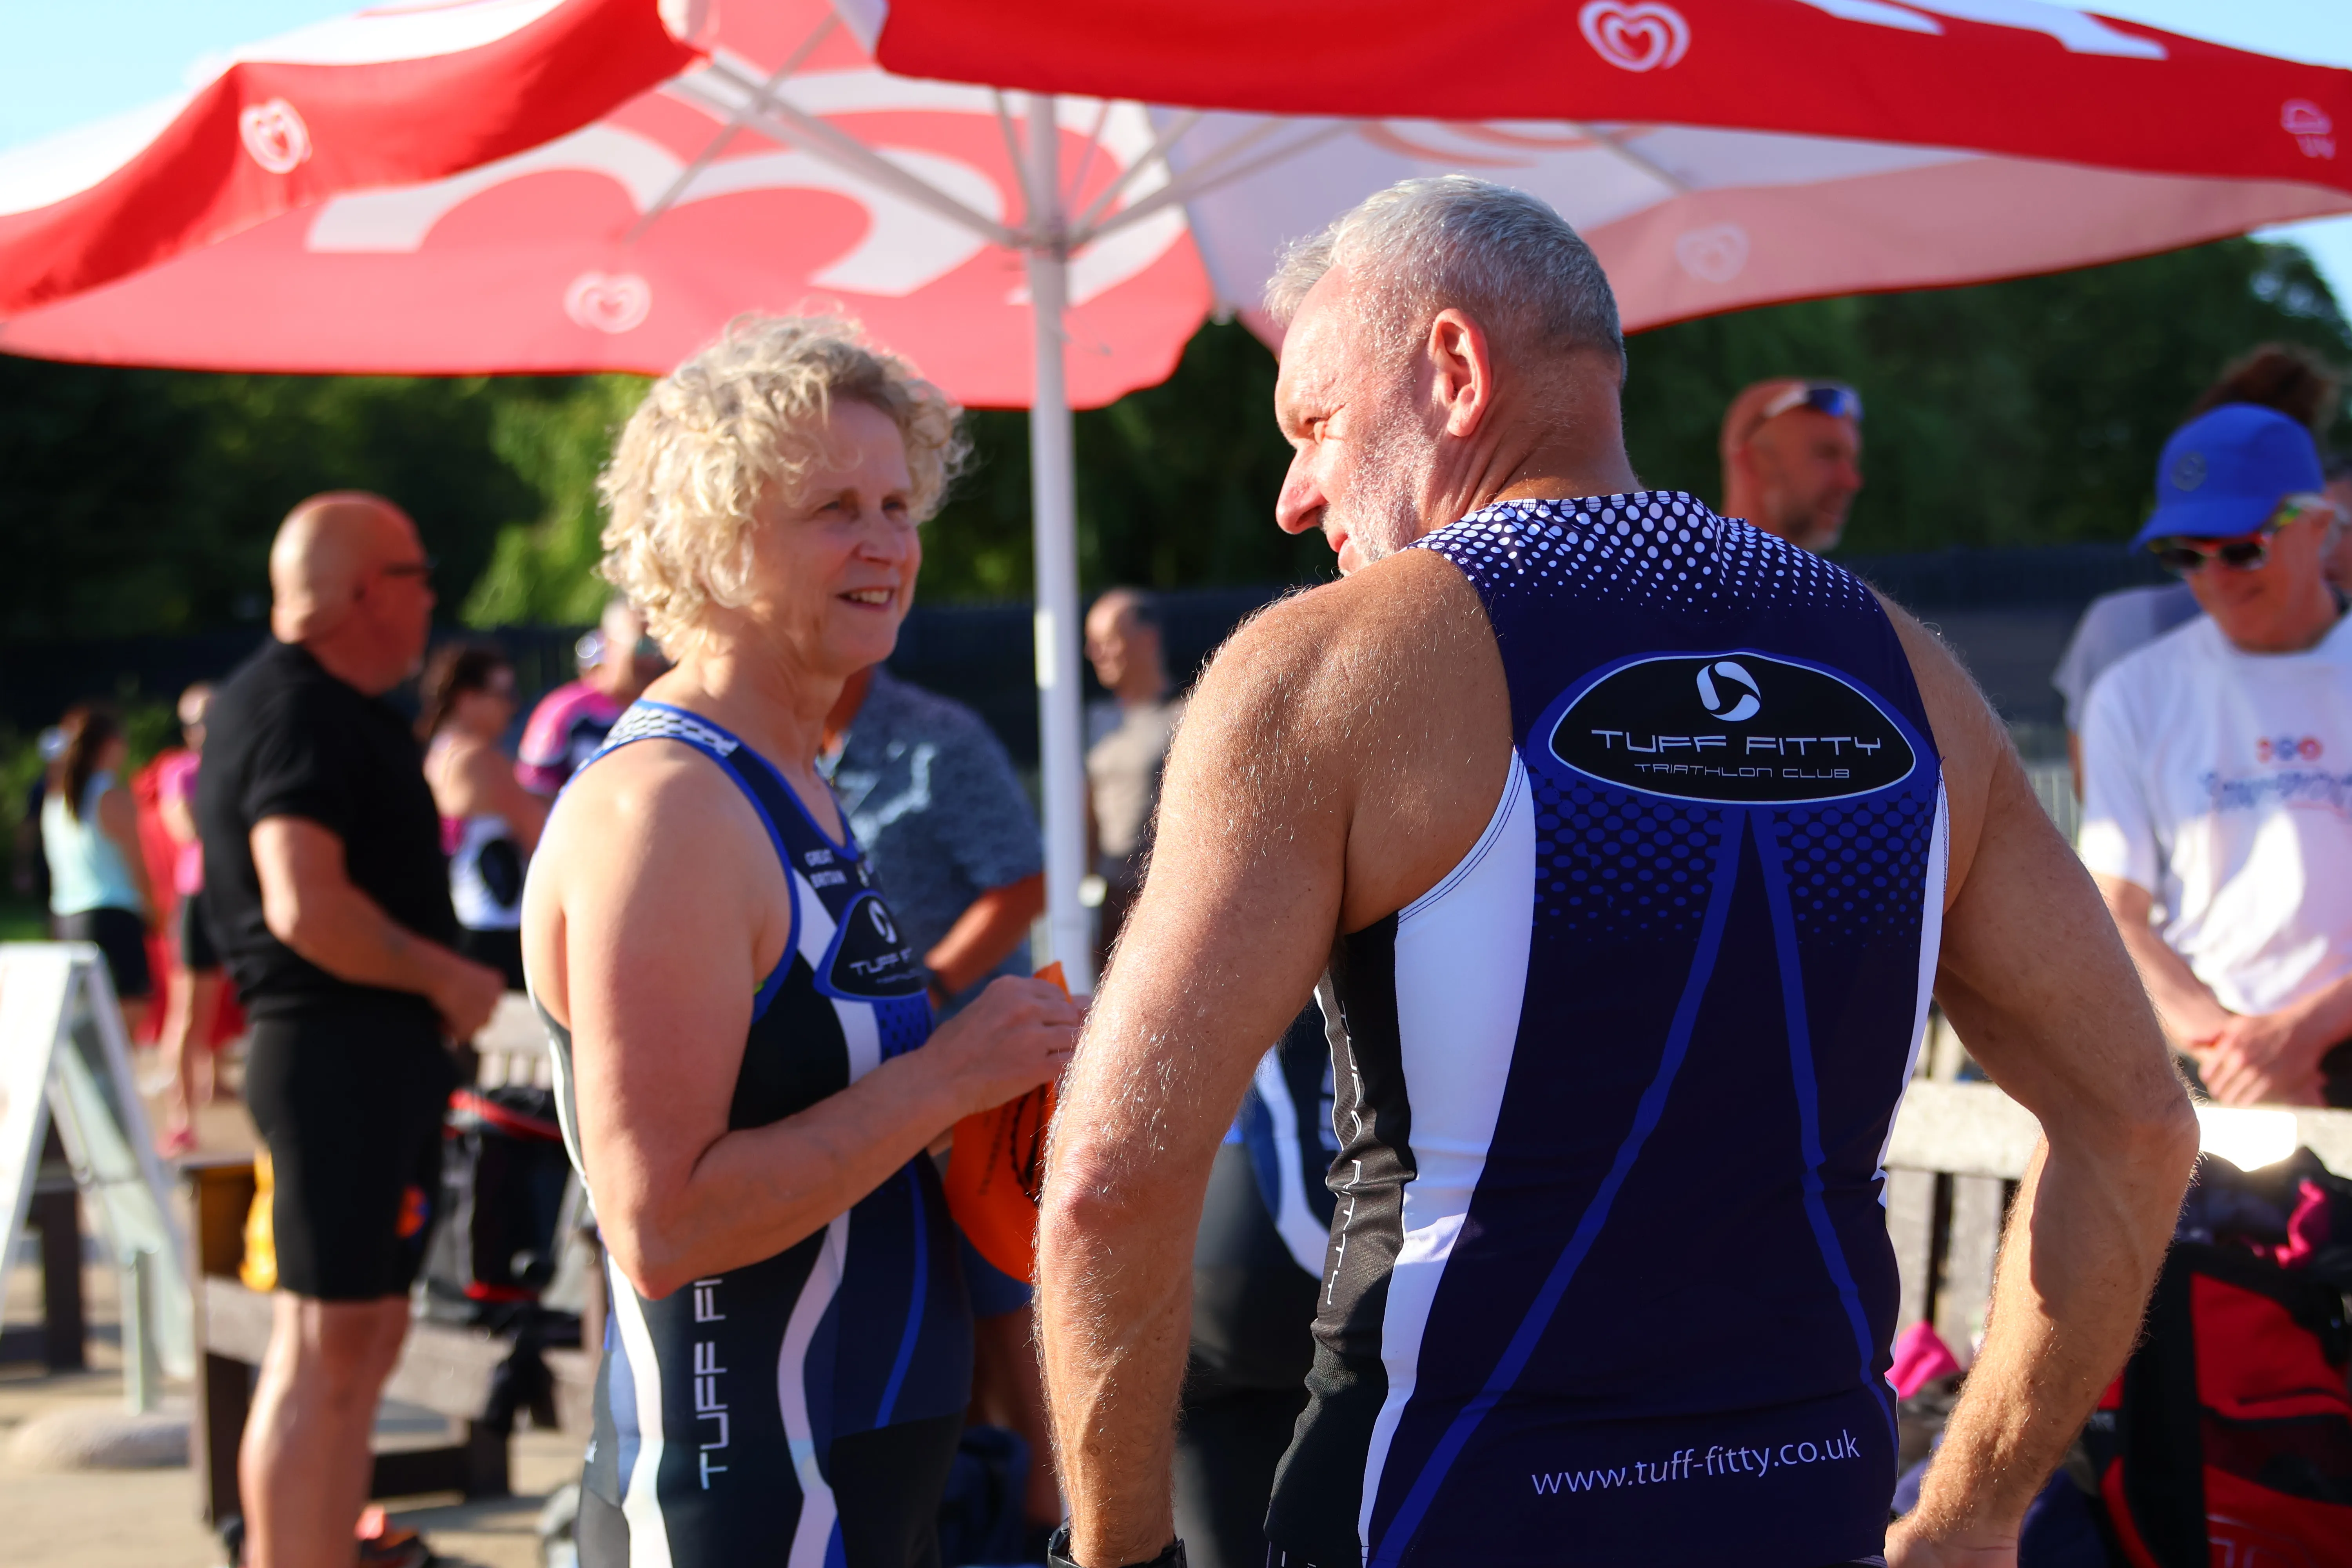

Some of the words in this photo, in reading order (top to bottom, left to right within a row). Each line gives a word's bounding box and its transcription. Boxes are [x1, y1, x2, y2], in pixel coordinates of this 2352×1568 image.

[1592, 730, 1727, 753] TUFF
[1746, 736, 1881, 756] FITTY
[1634, 764, 1773, 777] TRIATHLON
[1782, 768, 1849, 778] CLUB
[694, 1341, 728, 1489] TUFF
[1532, 1429, 1860, 1495] www.tuff-fitty.co.uk
